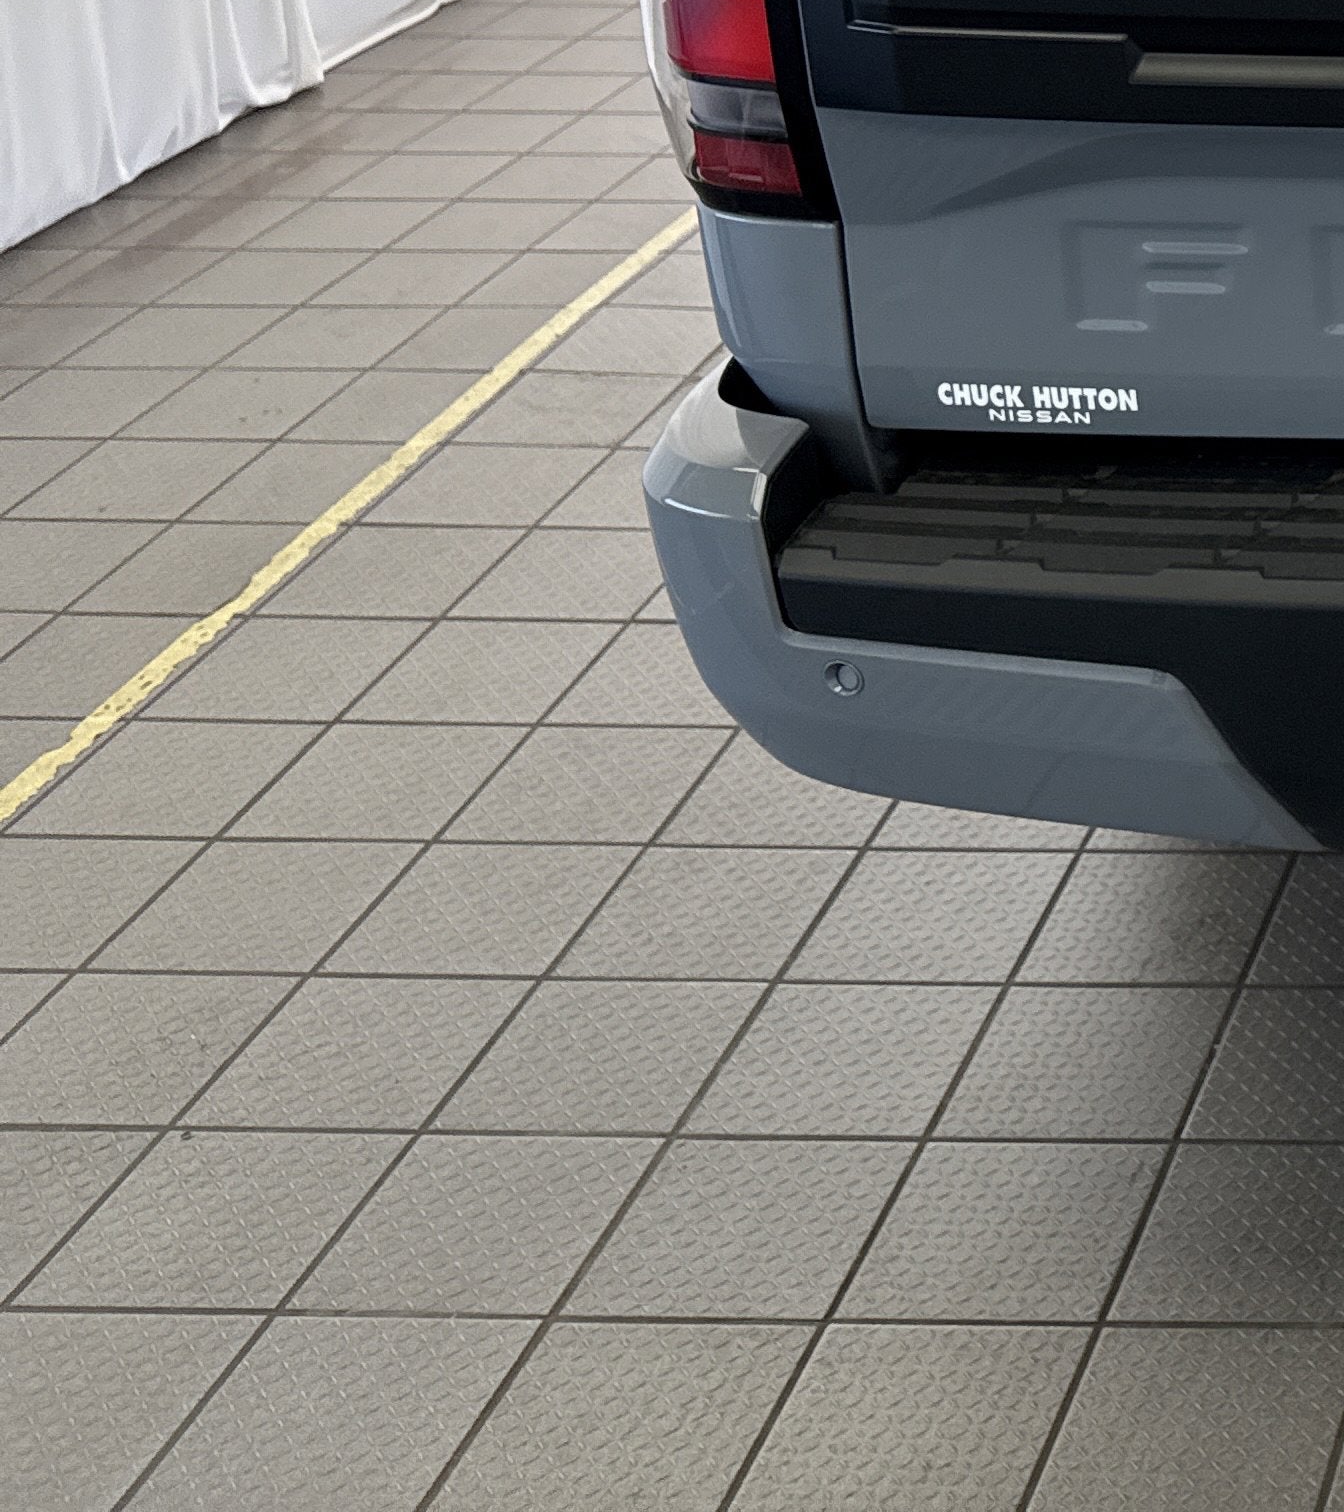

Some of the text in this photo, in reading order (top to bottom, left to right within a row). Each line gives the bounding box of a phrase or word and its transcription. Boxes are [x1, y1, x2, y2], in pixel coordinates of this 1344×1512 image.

[937, 382, 1139, 412] CHUCK HUTTON
[988, 408, 1091, 425] NISSAN
